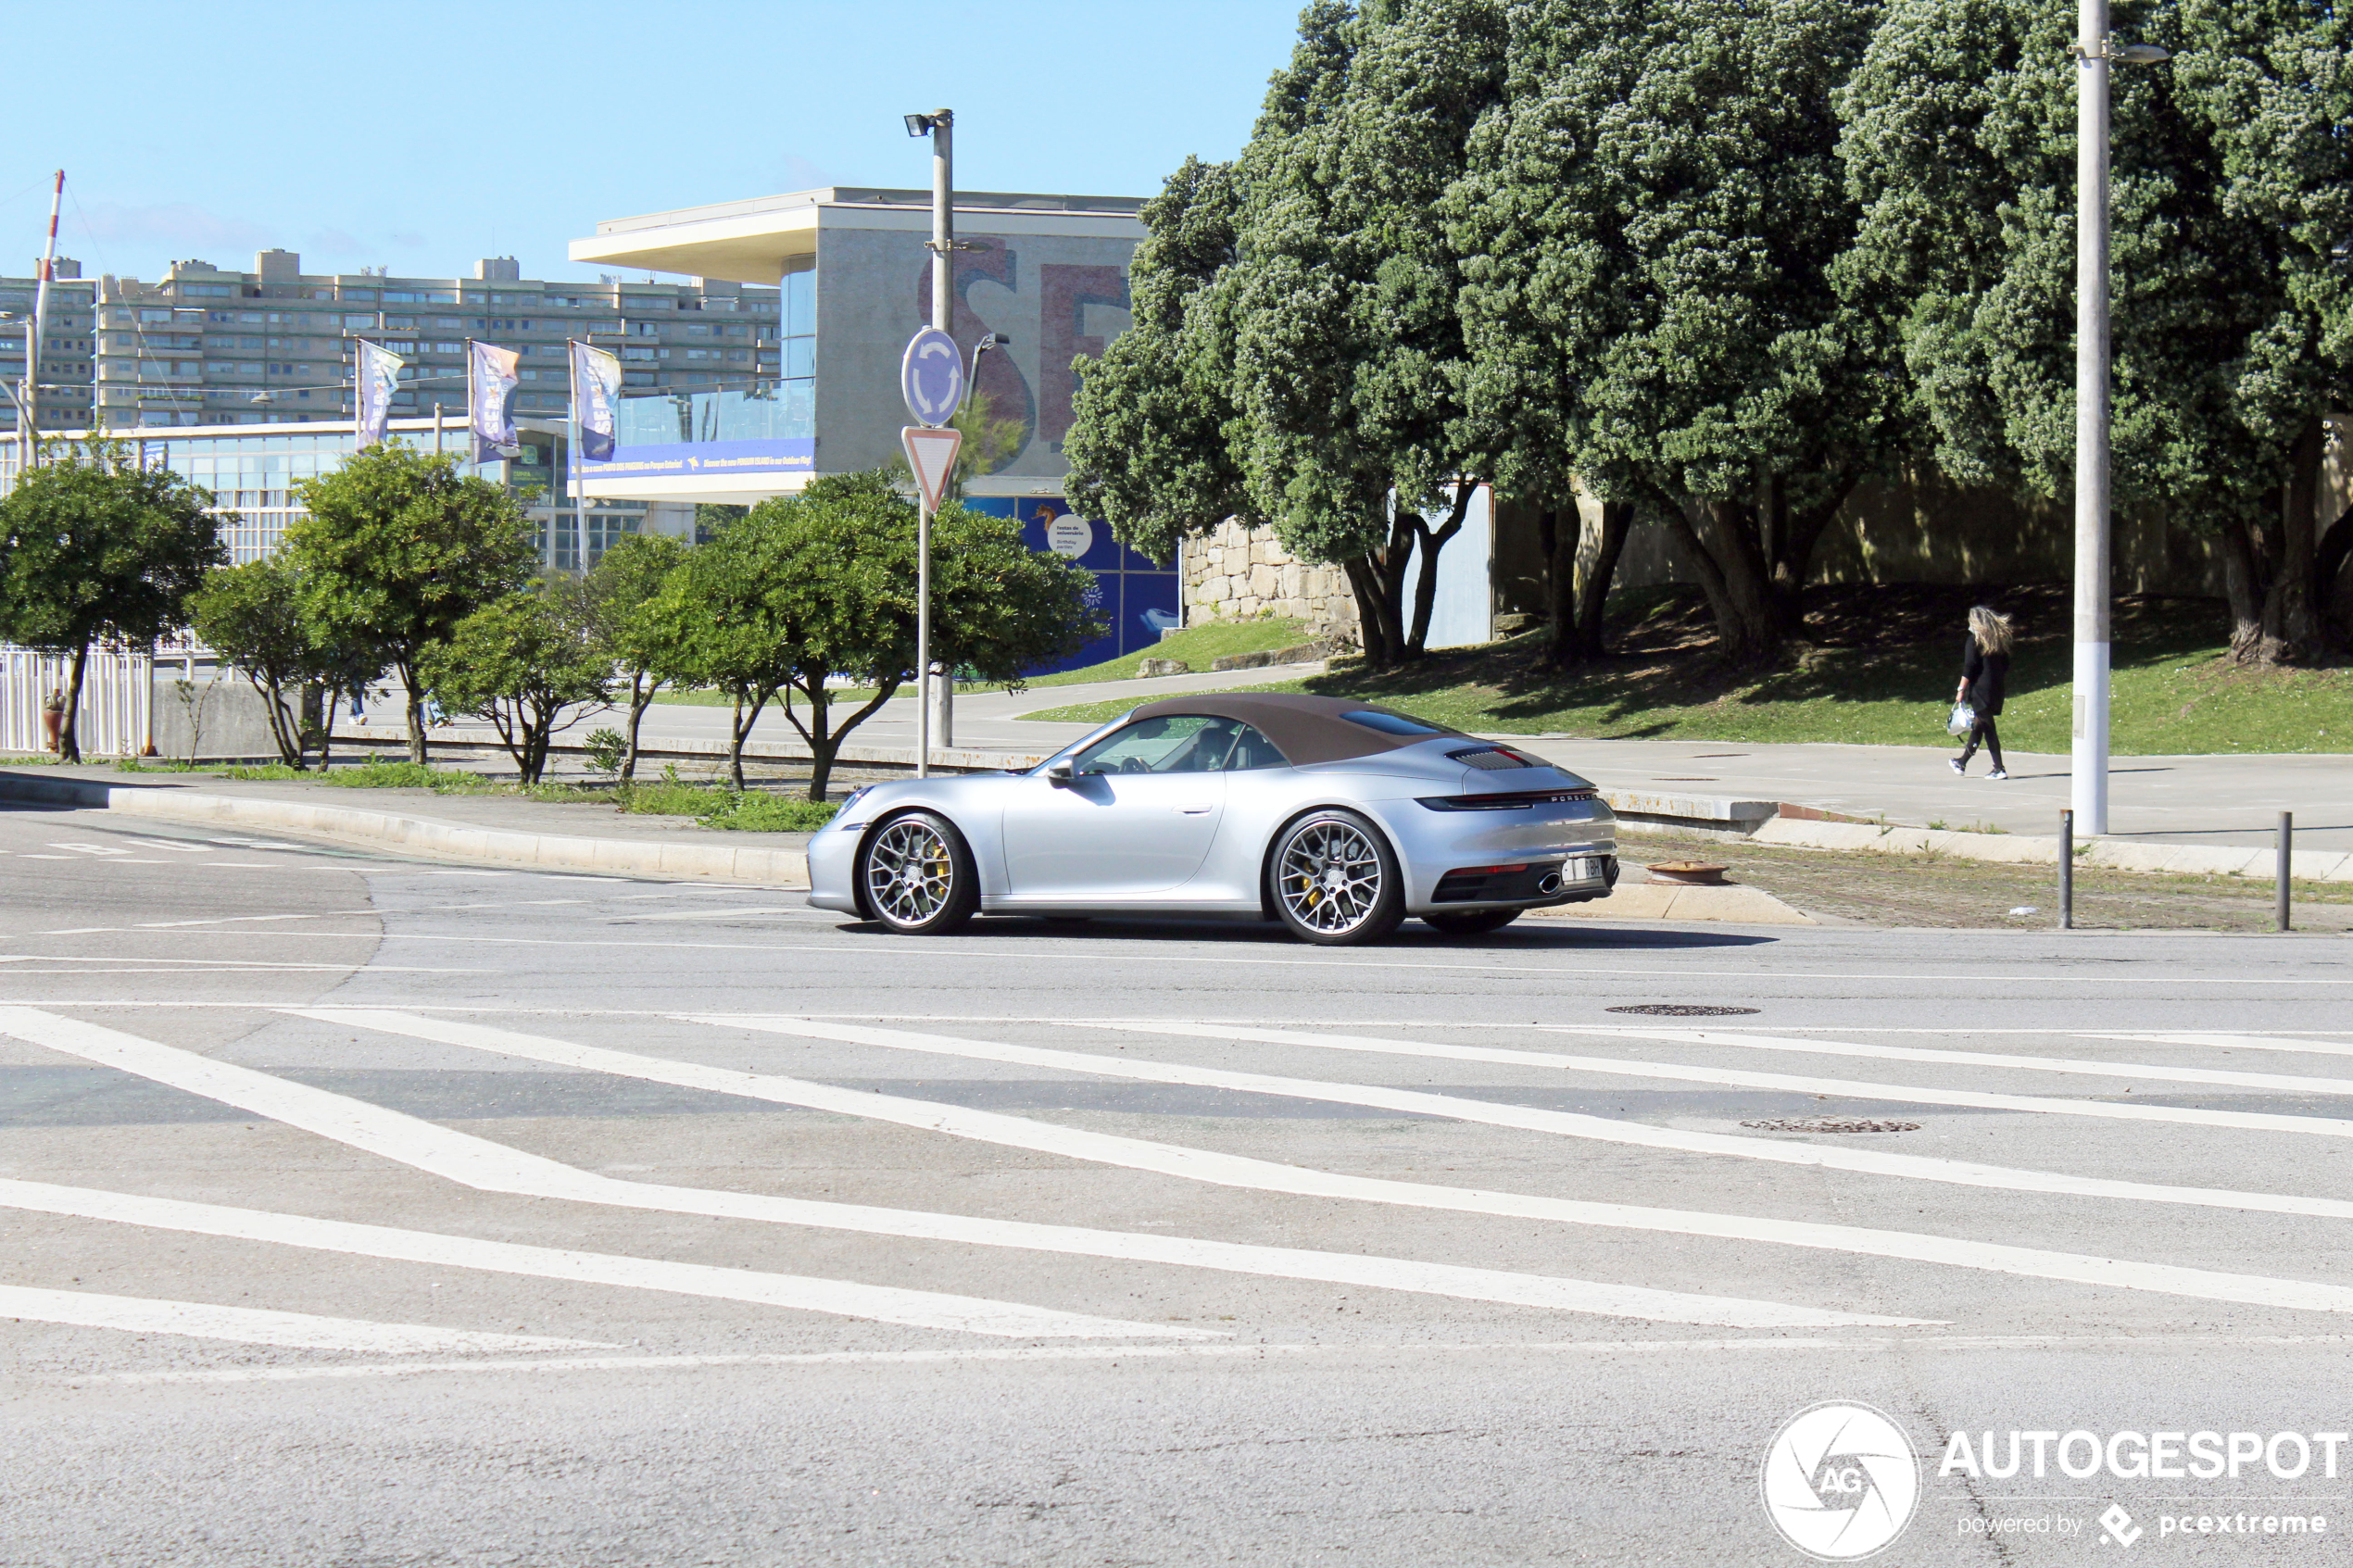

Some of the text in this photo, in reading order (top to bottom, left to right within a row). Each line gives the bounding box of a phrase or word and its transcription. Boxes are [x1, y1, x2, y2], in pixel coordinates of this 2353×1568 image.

[484, 397, 500, 434] SEA
[592, 396, 611, 433] SEA
[616, 462, 624, 471] DOS
[650, 461, 664, 471] Parque
[704, 458, 720, 468] Discover
[736, 458, 754, 466] PENGUIN
[754, 457, 769, 465] ISLAND
[769, 456, 774, 465] in
[782, 456, 799, 465] Outdoor
[799, 456, 812, 466] Play!
